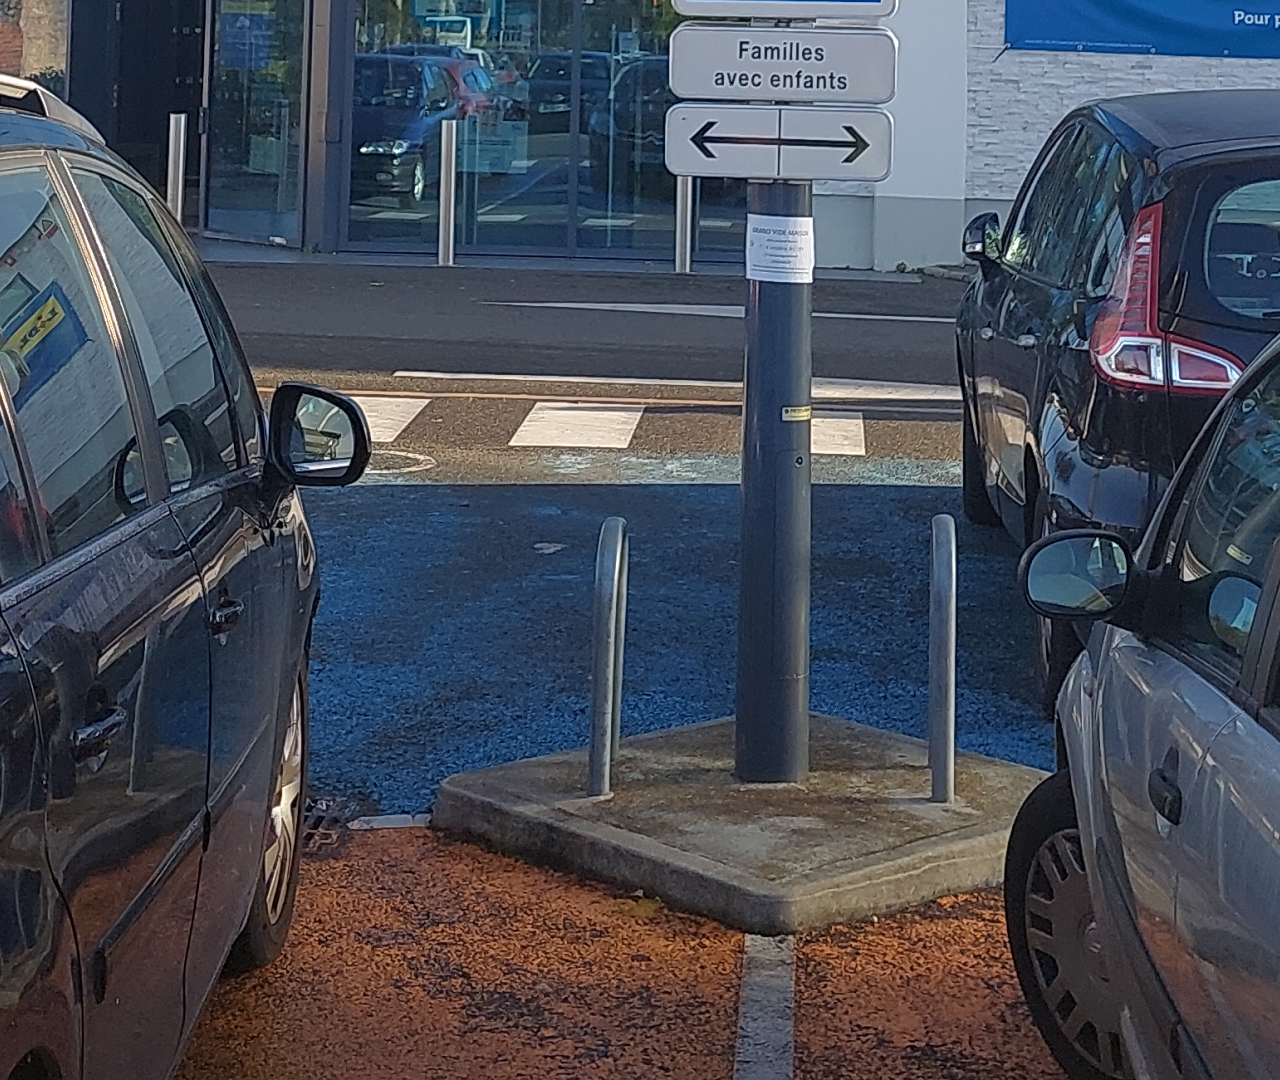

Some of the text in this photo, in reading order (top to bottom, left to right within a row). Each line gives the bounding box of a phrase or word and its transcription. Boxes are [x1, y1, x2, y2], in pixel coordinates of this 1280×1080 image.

[1234, 10, 1270, 26] Pour
[738, 40, 825, 62] Familles
[714, 69, 848, 90] avec enfants
